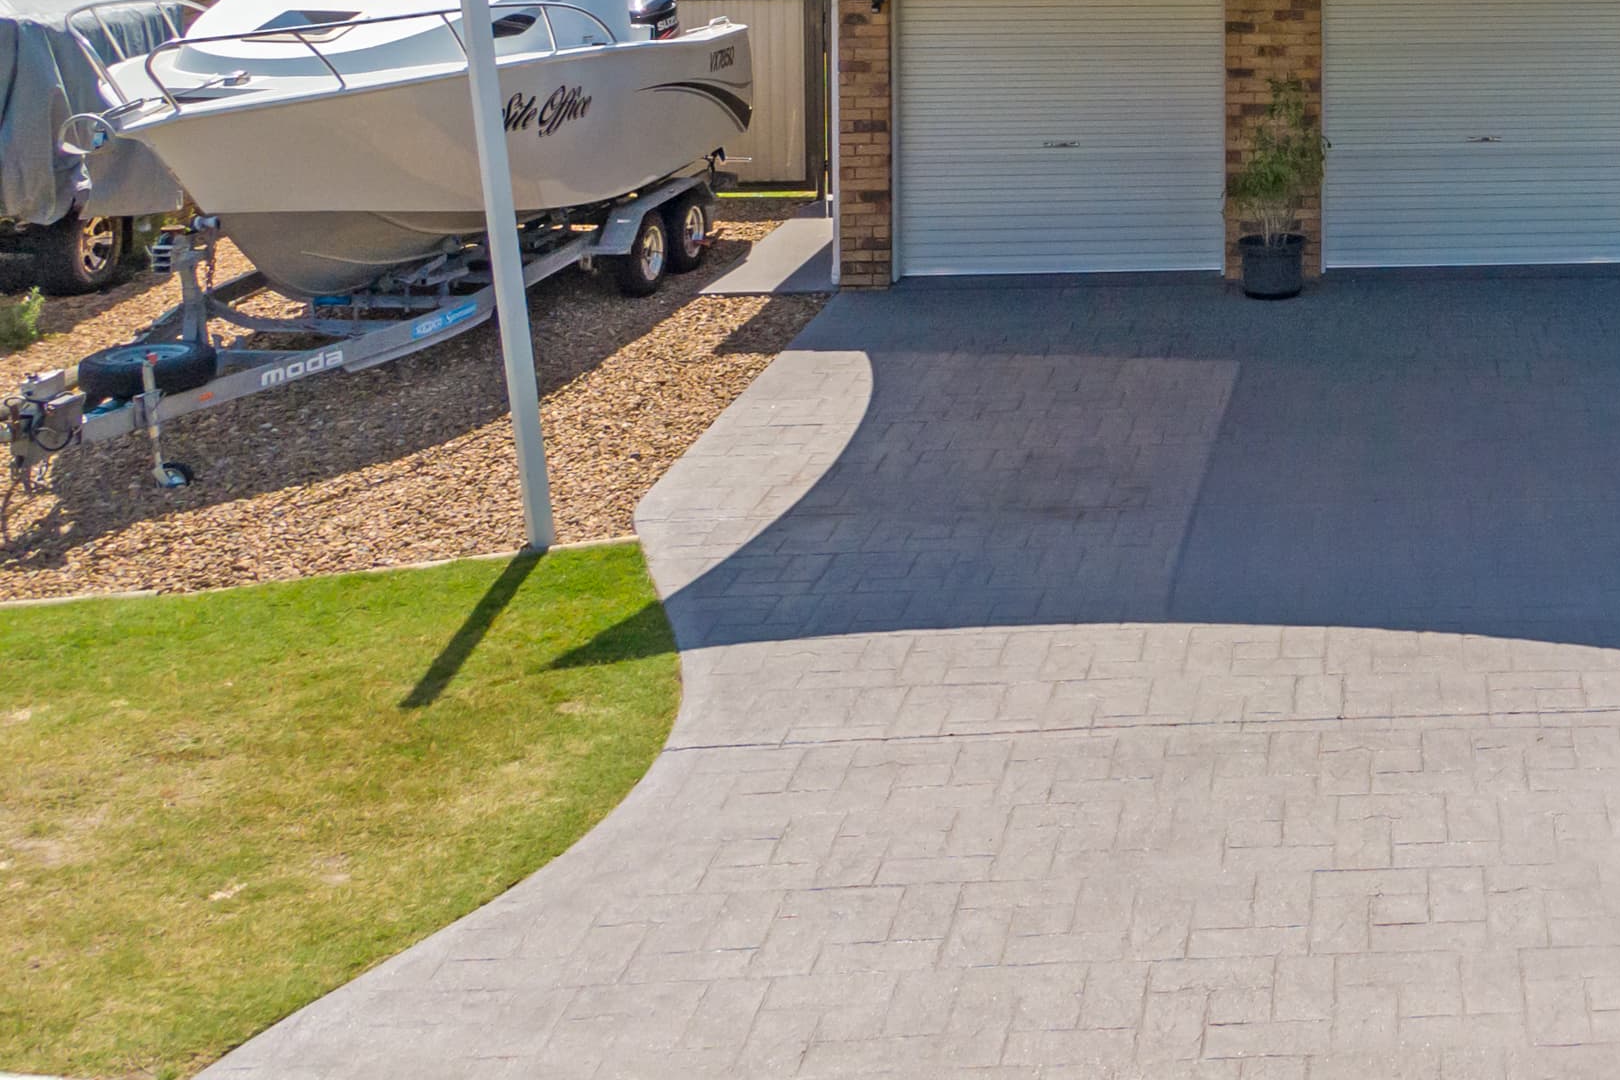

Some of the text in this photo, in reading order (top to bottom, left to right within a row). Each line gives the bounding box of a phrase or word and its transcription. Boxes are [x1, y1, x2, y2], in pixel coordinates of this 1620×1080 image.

[656, 15, 677, 31] SUZ
[538, 85, 592, 137] Office
[260, 349, 344, 387] moda
